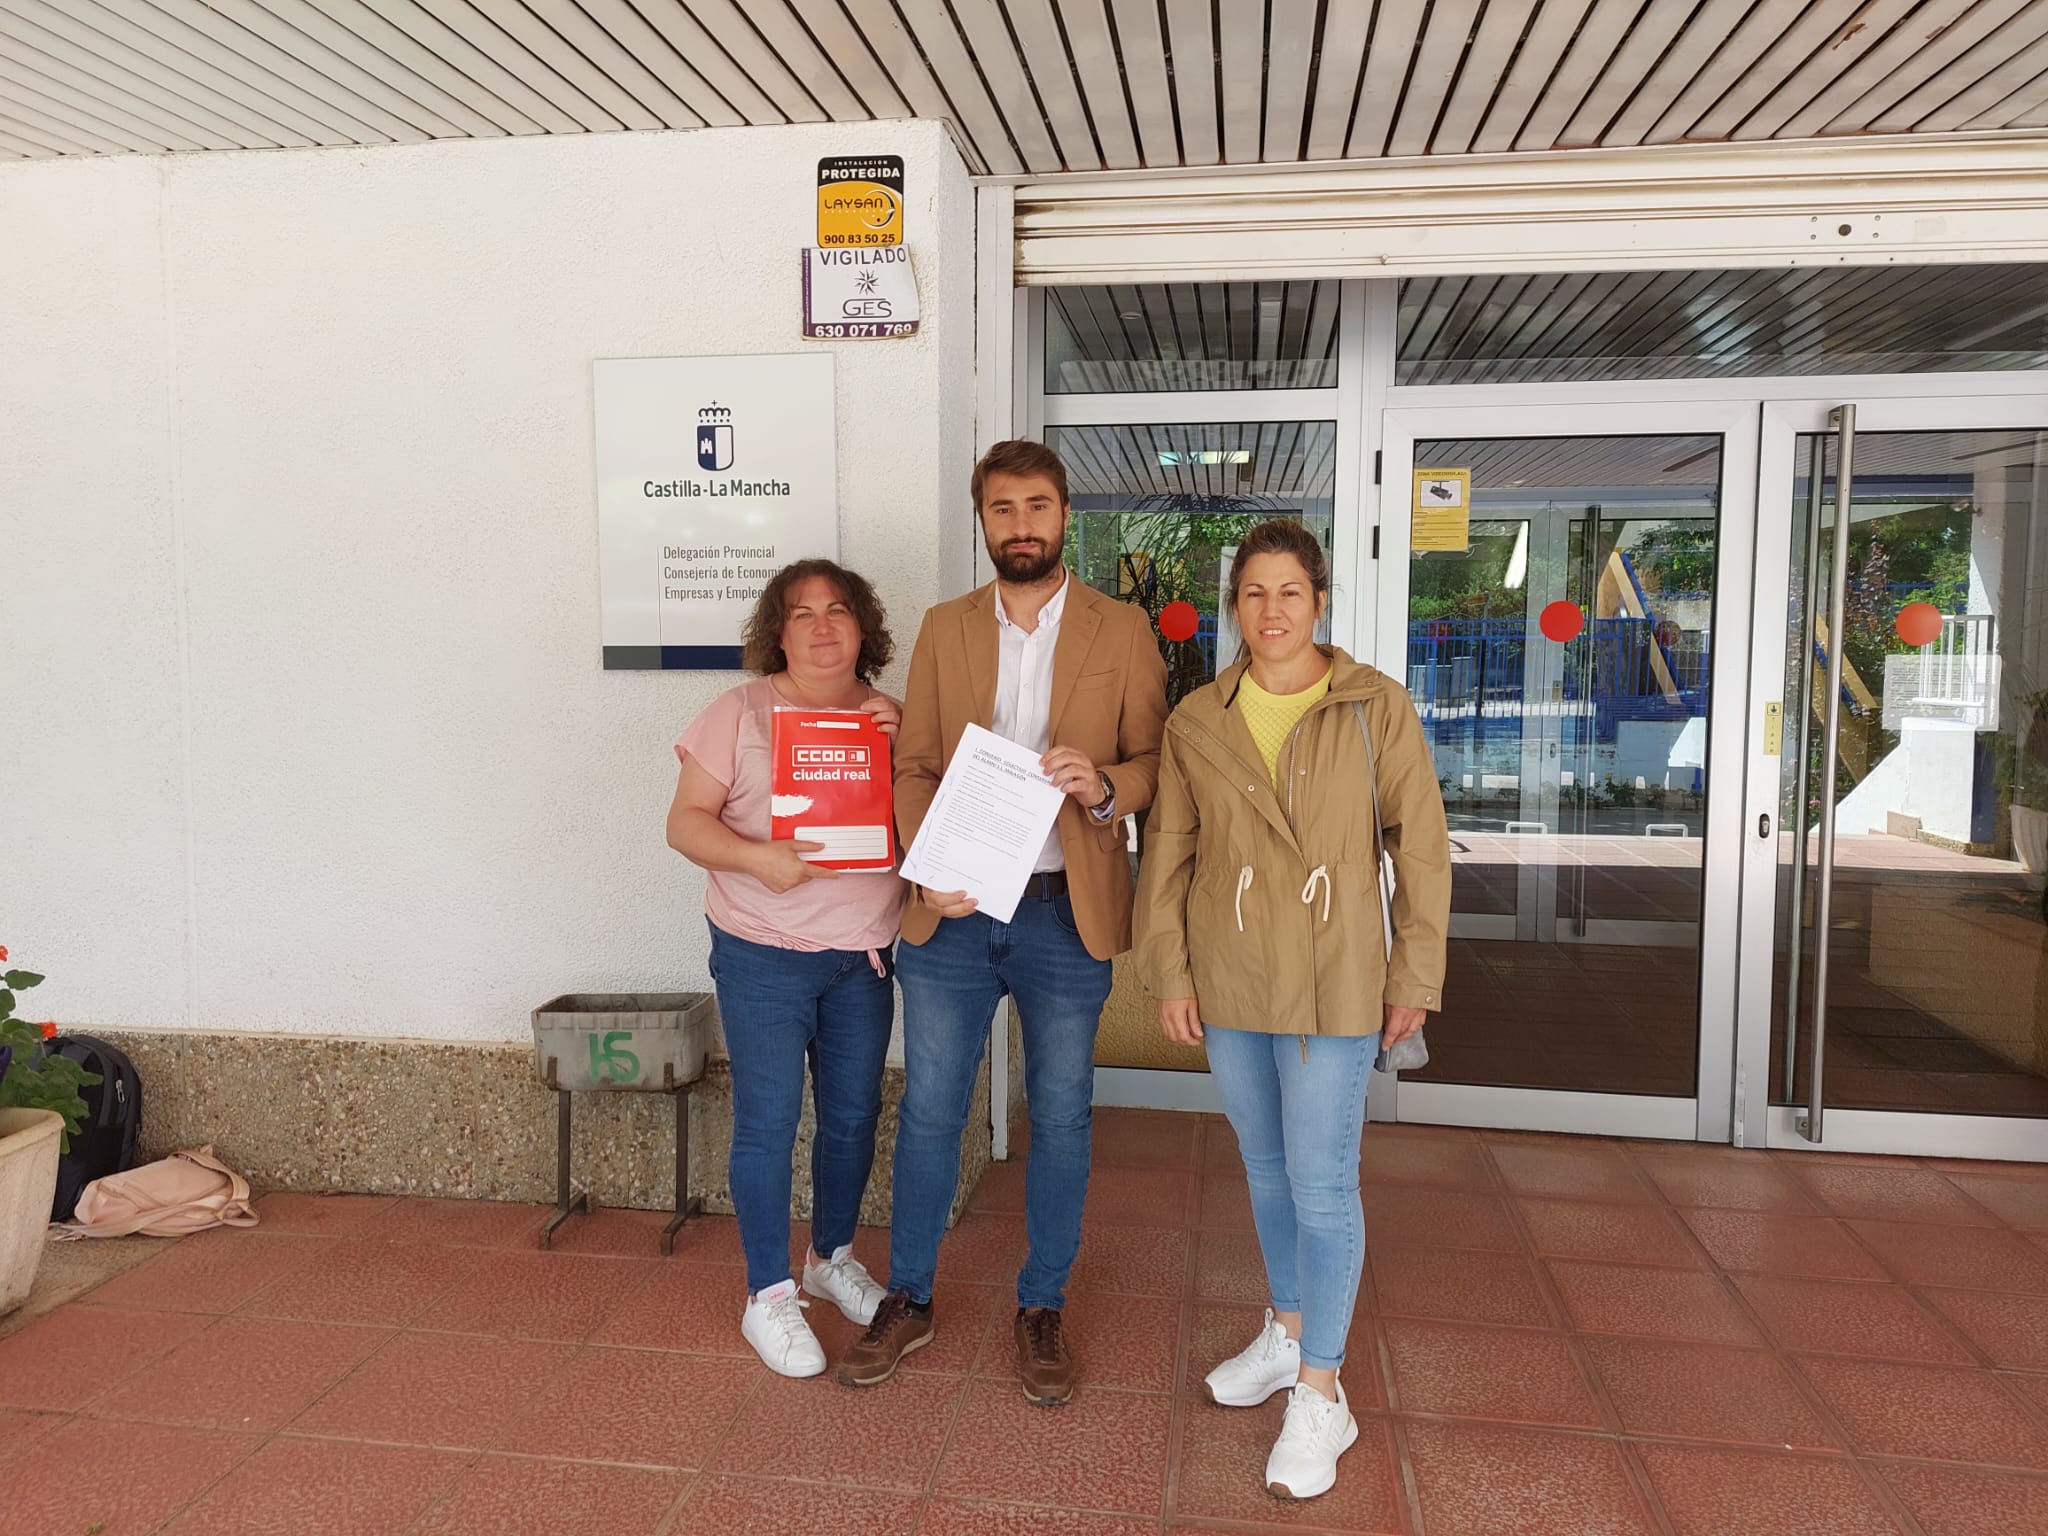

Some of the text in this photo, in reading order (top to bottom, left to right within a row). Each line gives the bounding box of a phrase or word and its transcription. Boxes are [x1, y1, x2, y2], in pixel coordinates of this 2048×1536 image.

[822, 168, 901, 179] PROTEGIDA
[824, 198, 883, 209] LAYSAN
[824, 233, 895, 243] 900 83 50 25
[820, 248, 907, 265] VIGILADO
[842, 299, 892, 318] GES
[815, 325, 844, 337] 630
[849, 325, 877, 337] 071
[730, 479, 790, 497] Mancha
[663, 545, 775, 561] Delegación Provincial
[664, 565, 784, 581] Consejería de Economí
[664, 586, 714, 601] Empresas
[717, 589, 723, 601] y
[797, 750, 846, 762] CCOO
[792, 768, 871, 781] ciudad real
